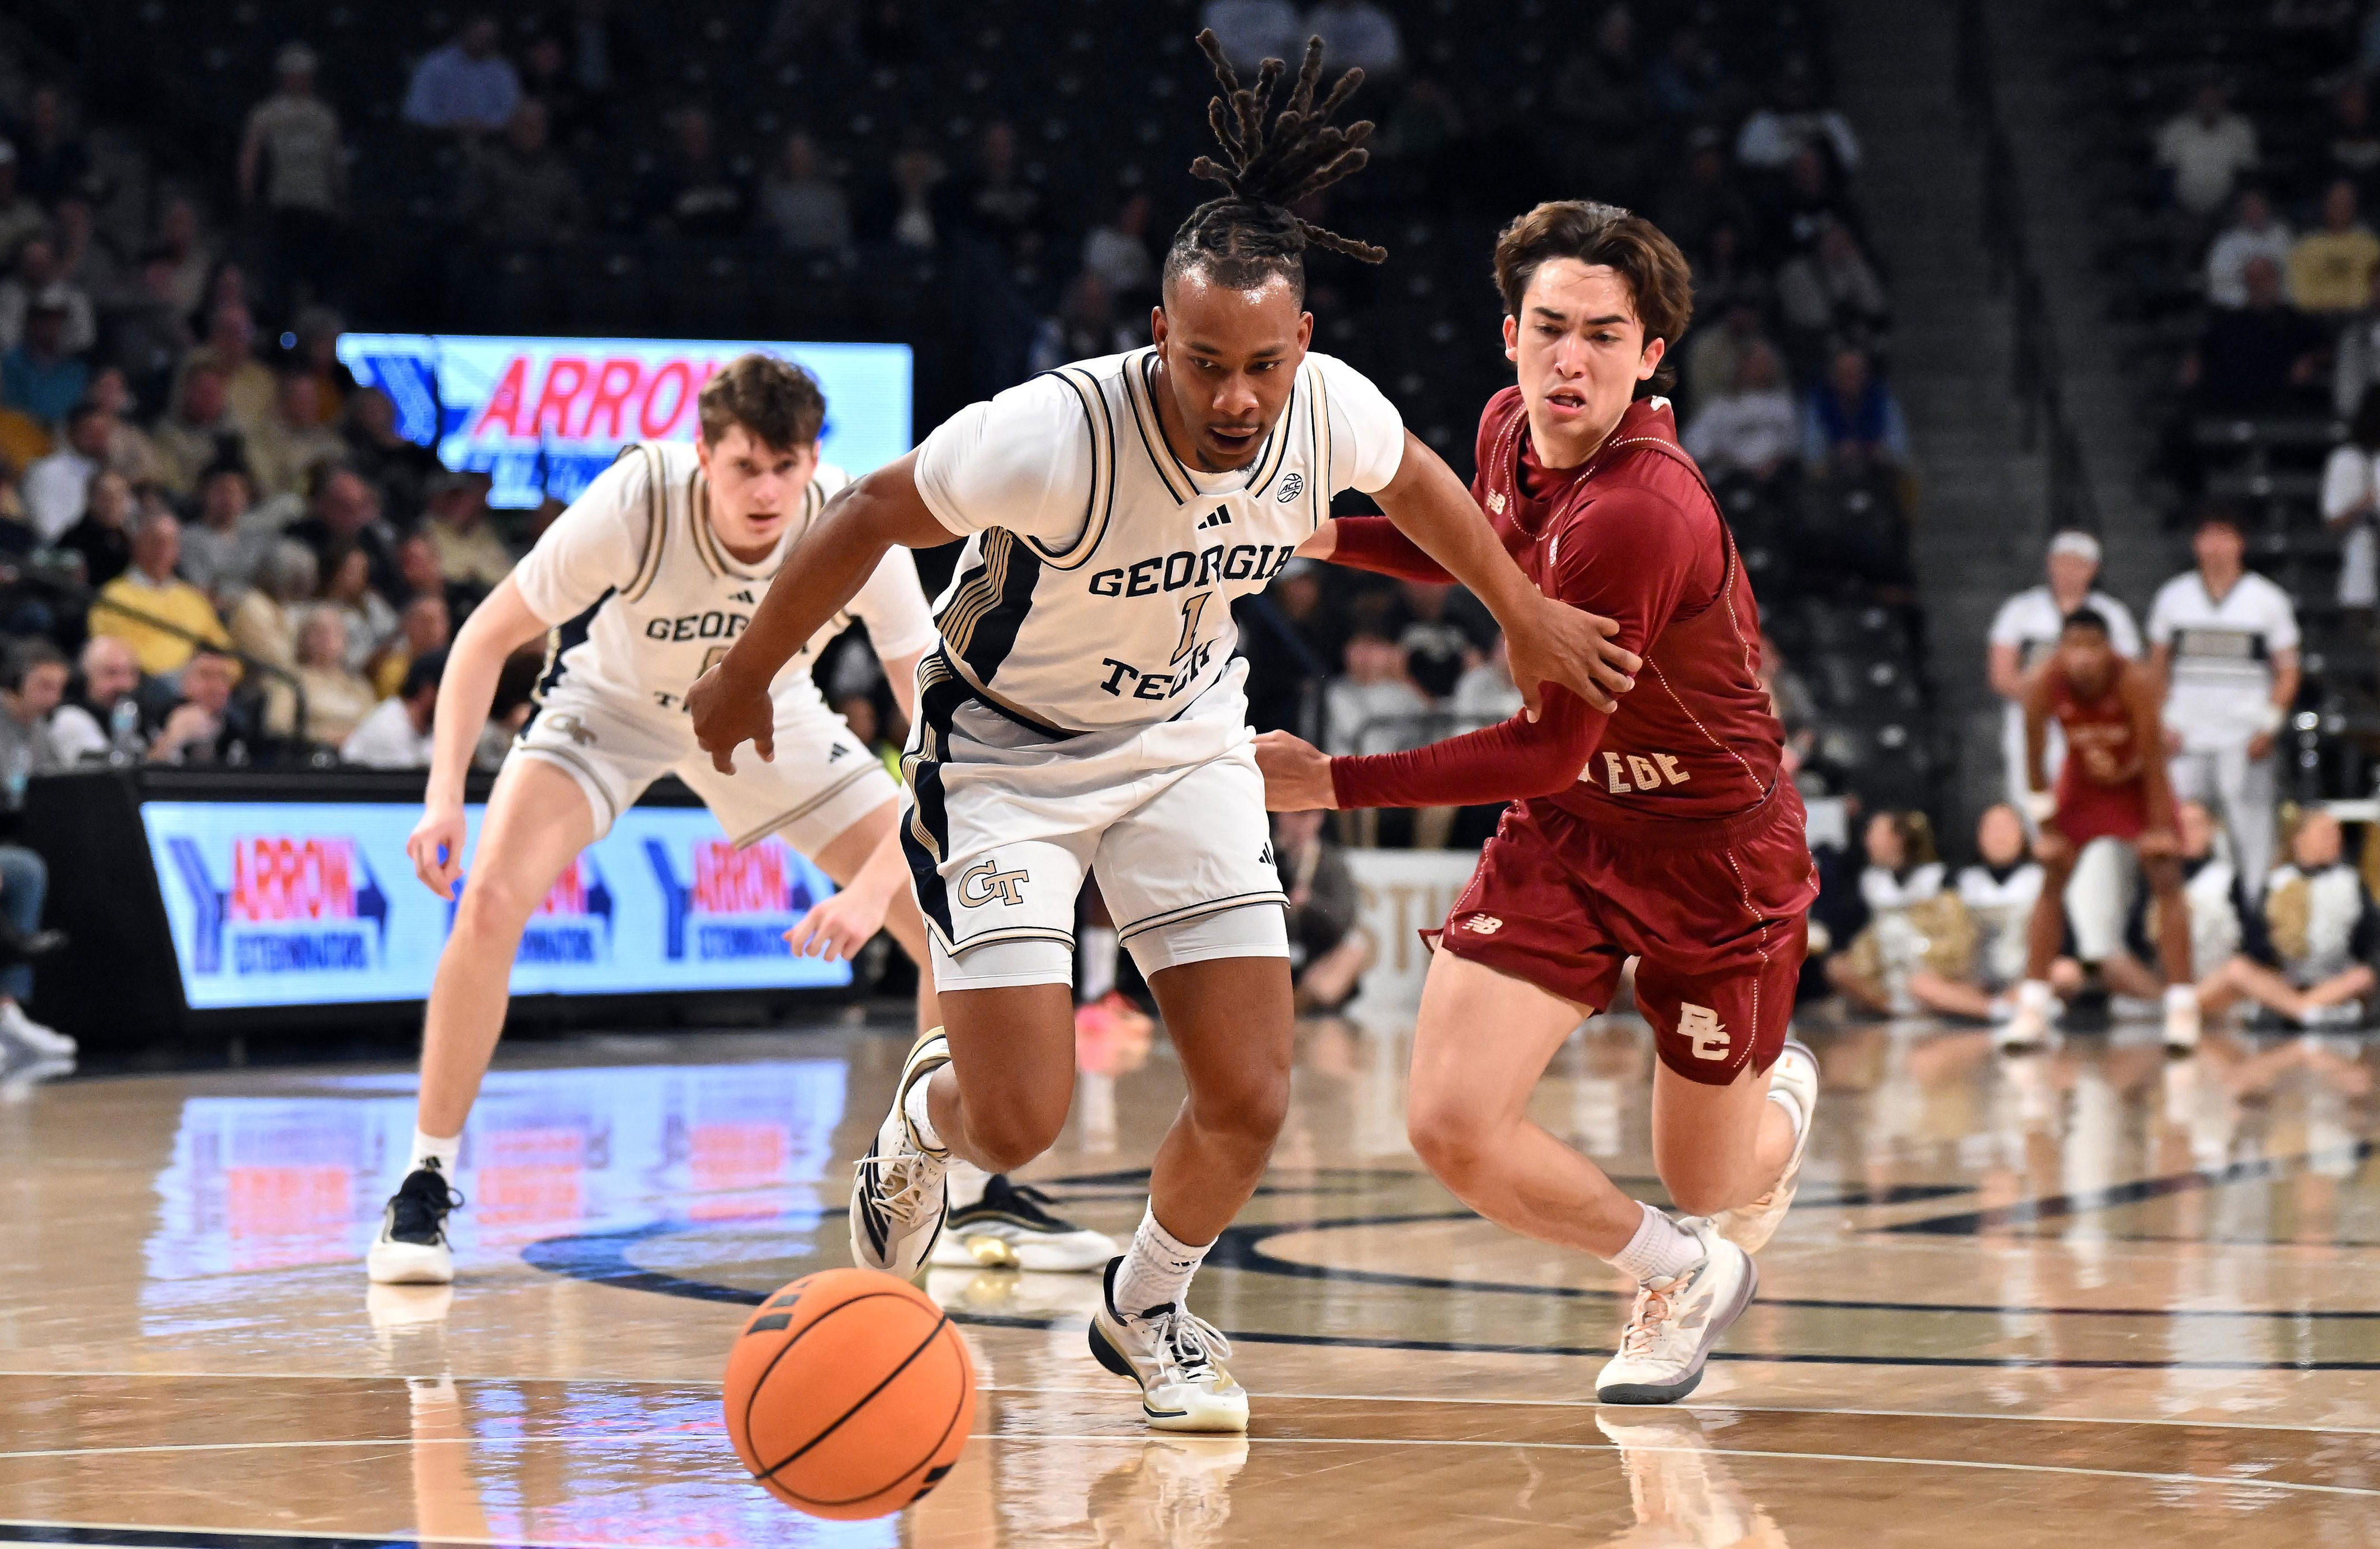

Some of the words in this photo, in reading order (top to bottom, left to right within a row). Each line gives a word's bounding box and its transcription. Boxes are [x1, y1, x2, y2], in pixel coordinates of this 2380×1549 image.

[475, 357, 708, 439] ARRO
[1279, 480, 1303, 494] ACC
[1088, 544, 1295, 598] GEORGIA
[646, 610, 751, 641] GEOR
[1169, 591, 1213, 667] 1
[1100, 636, 1222, 701] TECH
[1577, 752, 1691, 794] EGE
[958, 859, 1029, 909] GT
[1677, 1001, 1731, 1061] BC
